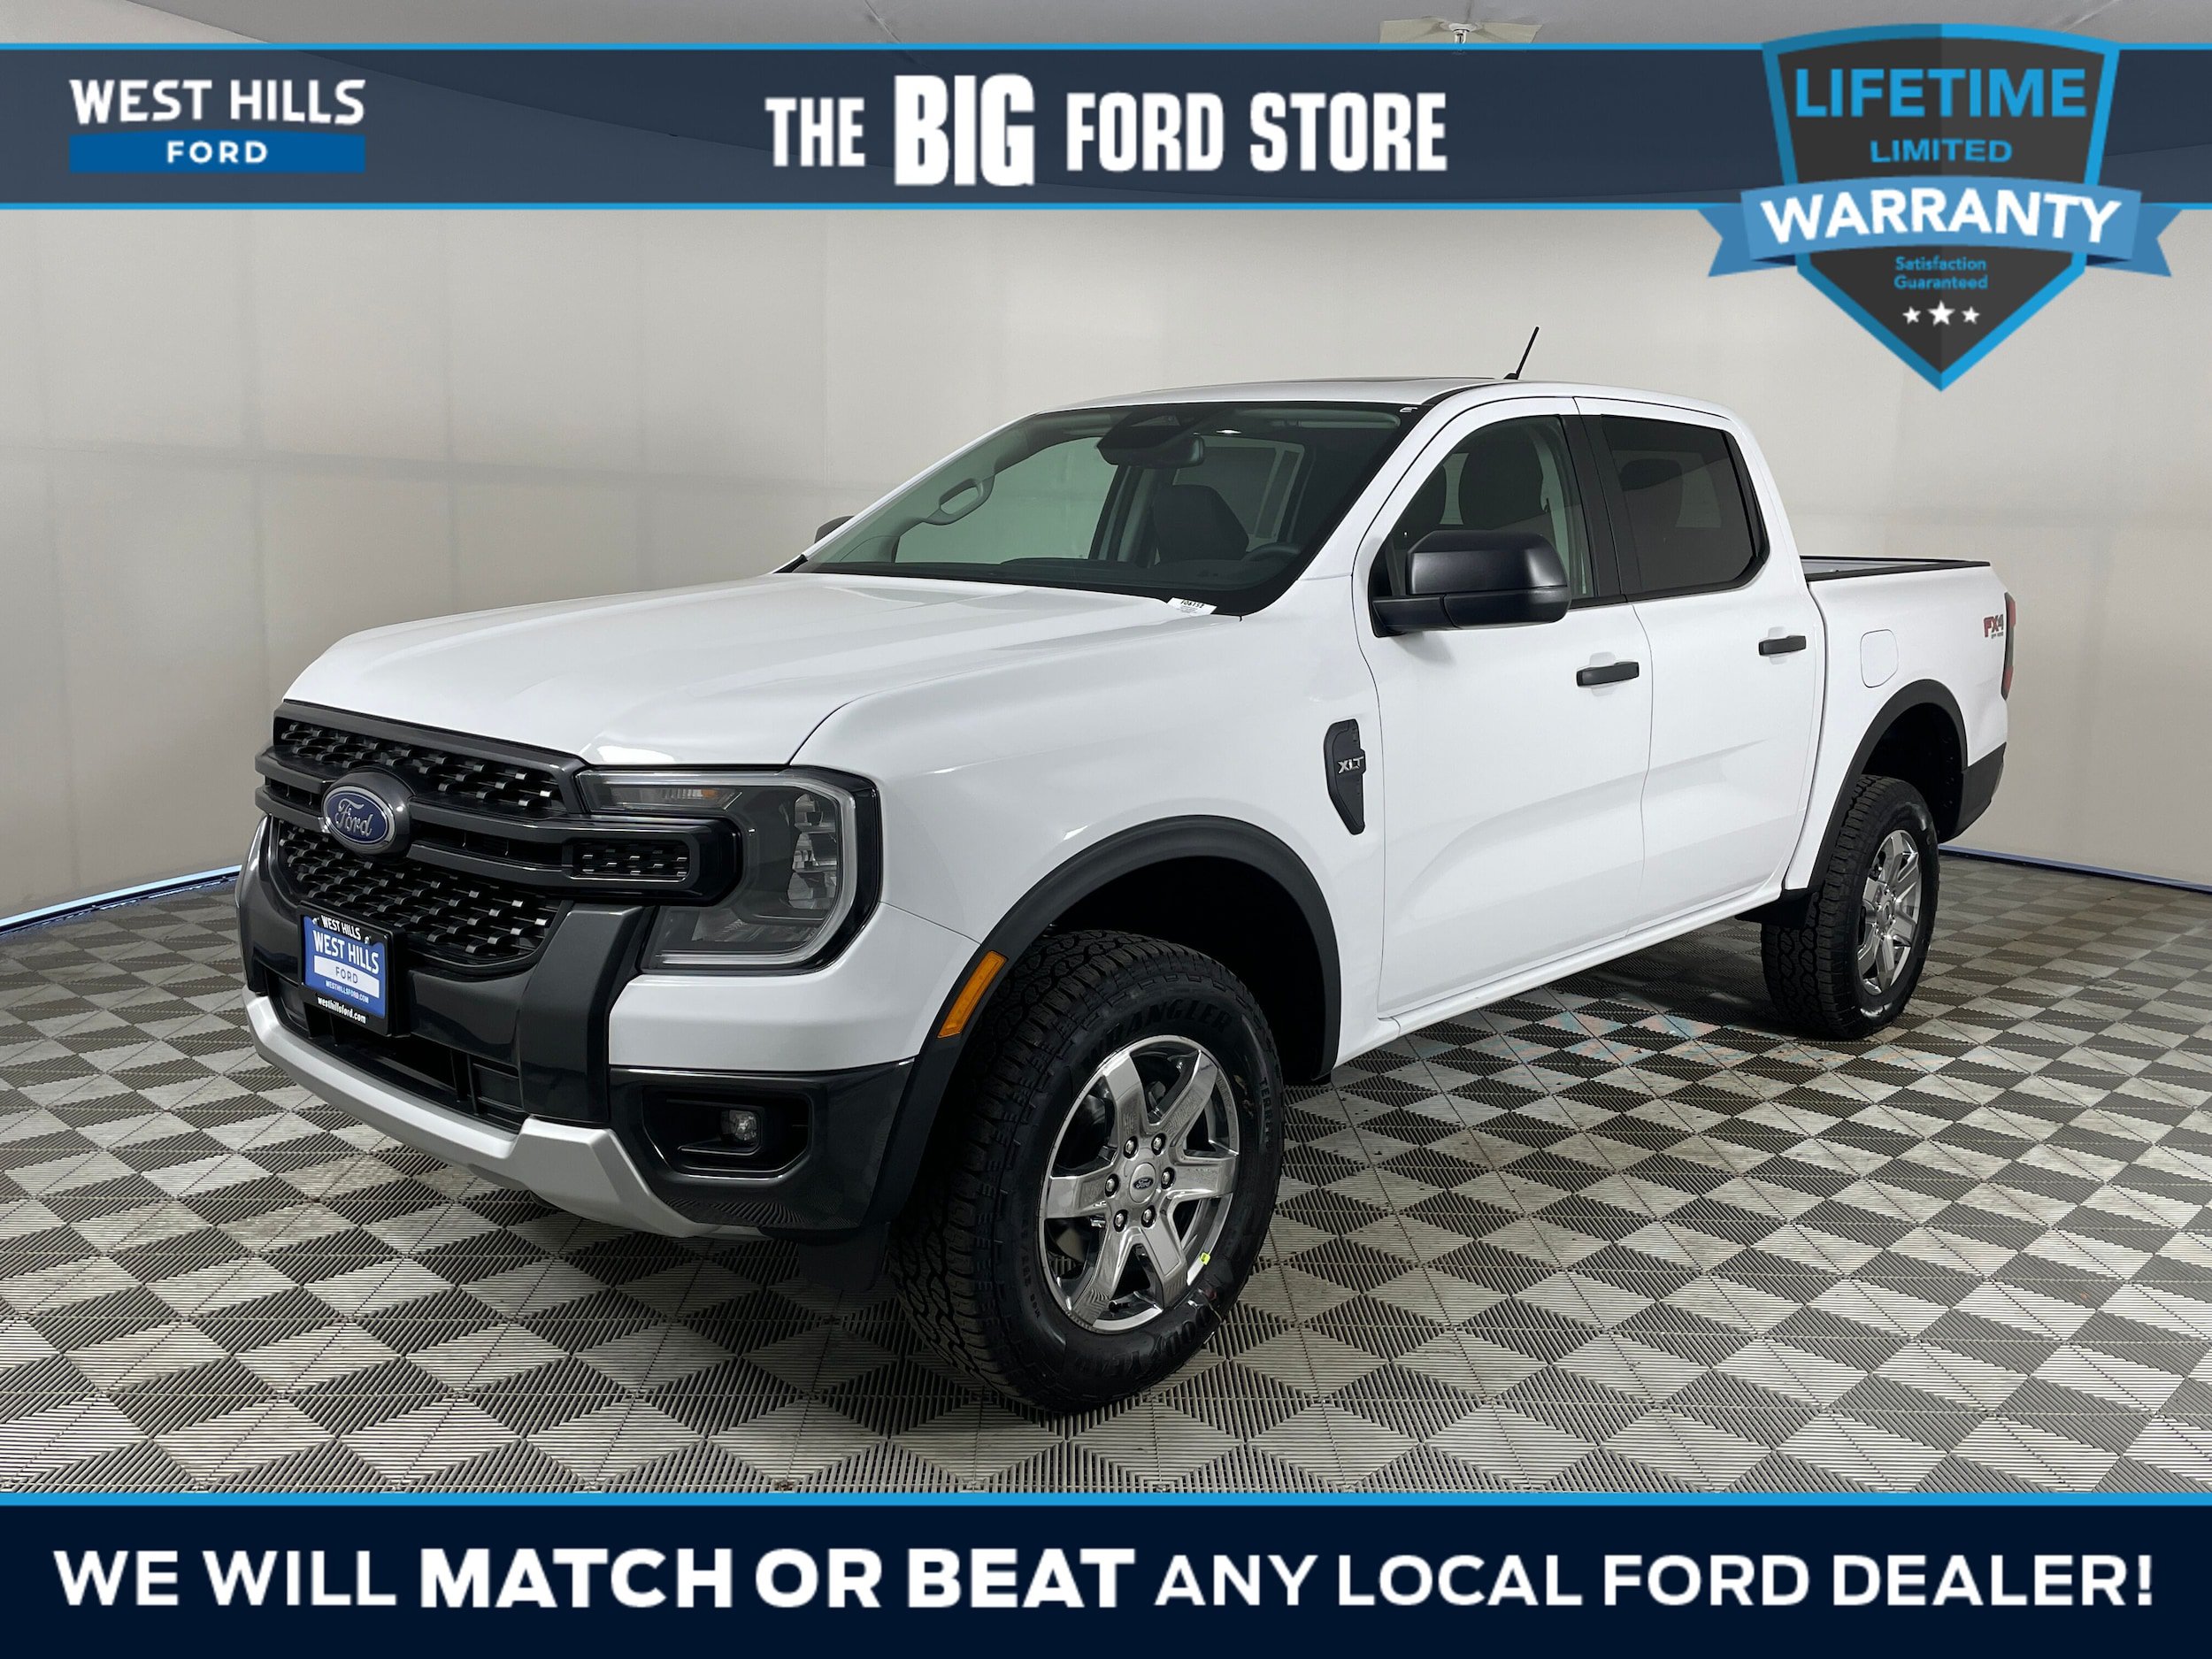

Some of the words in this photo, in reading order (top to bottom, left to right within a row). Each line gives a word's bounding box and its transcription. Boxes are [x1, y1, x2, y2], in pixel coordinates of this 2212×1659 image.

[1984, 614, 2004, 637] FX4
[1338, 757, 1364, 773] XLT
[334, 798, 373, 837] Ford
[321, 915, 341, 933] WEST
[341, 922, 361, 941] HILLS
[312, 930, 345, 959] WEST
[348, 942, 379, 974] HILLS
[335, 966, 358, 984] FORD
[325, 980, 370, 1003] WESTHILLSFORD.COM
[318, 996, 366, 1024] westhillsford.com
